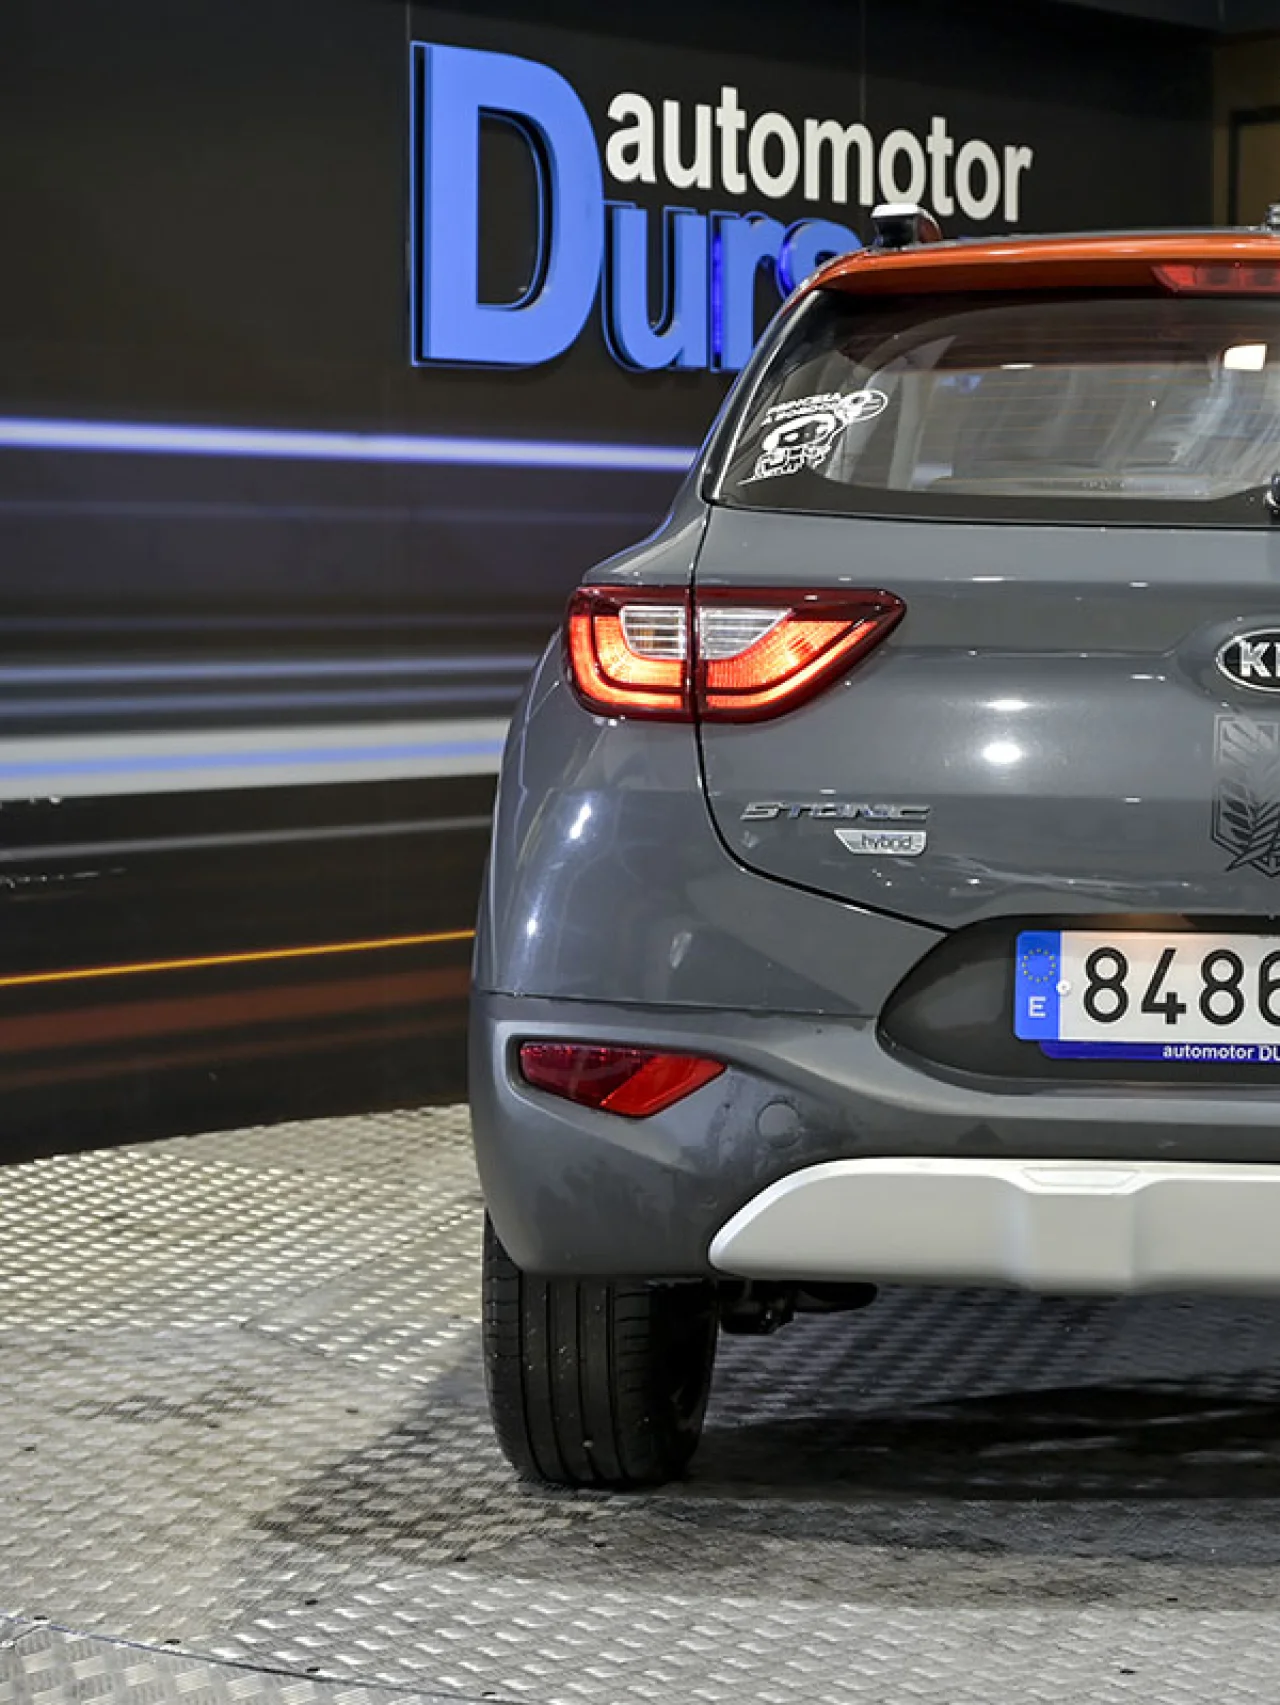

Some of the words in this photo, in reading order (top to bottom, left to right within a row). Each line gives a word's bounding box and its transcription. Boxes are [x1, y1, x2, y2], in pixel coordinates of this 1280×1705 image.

[606, 86, 1033, 222] automotor
[740, 802, 930, 820] STONIC
[861, 833, 914, 852] hybrid
[1028, 996, 1047, 1018] E
[1162, 1044, 1255, 1060] automotor
